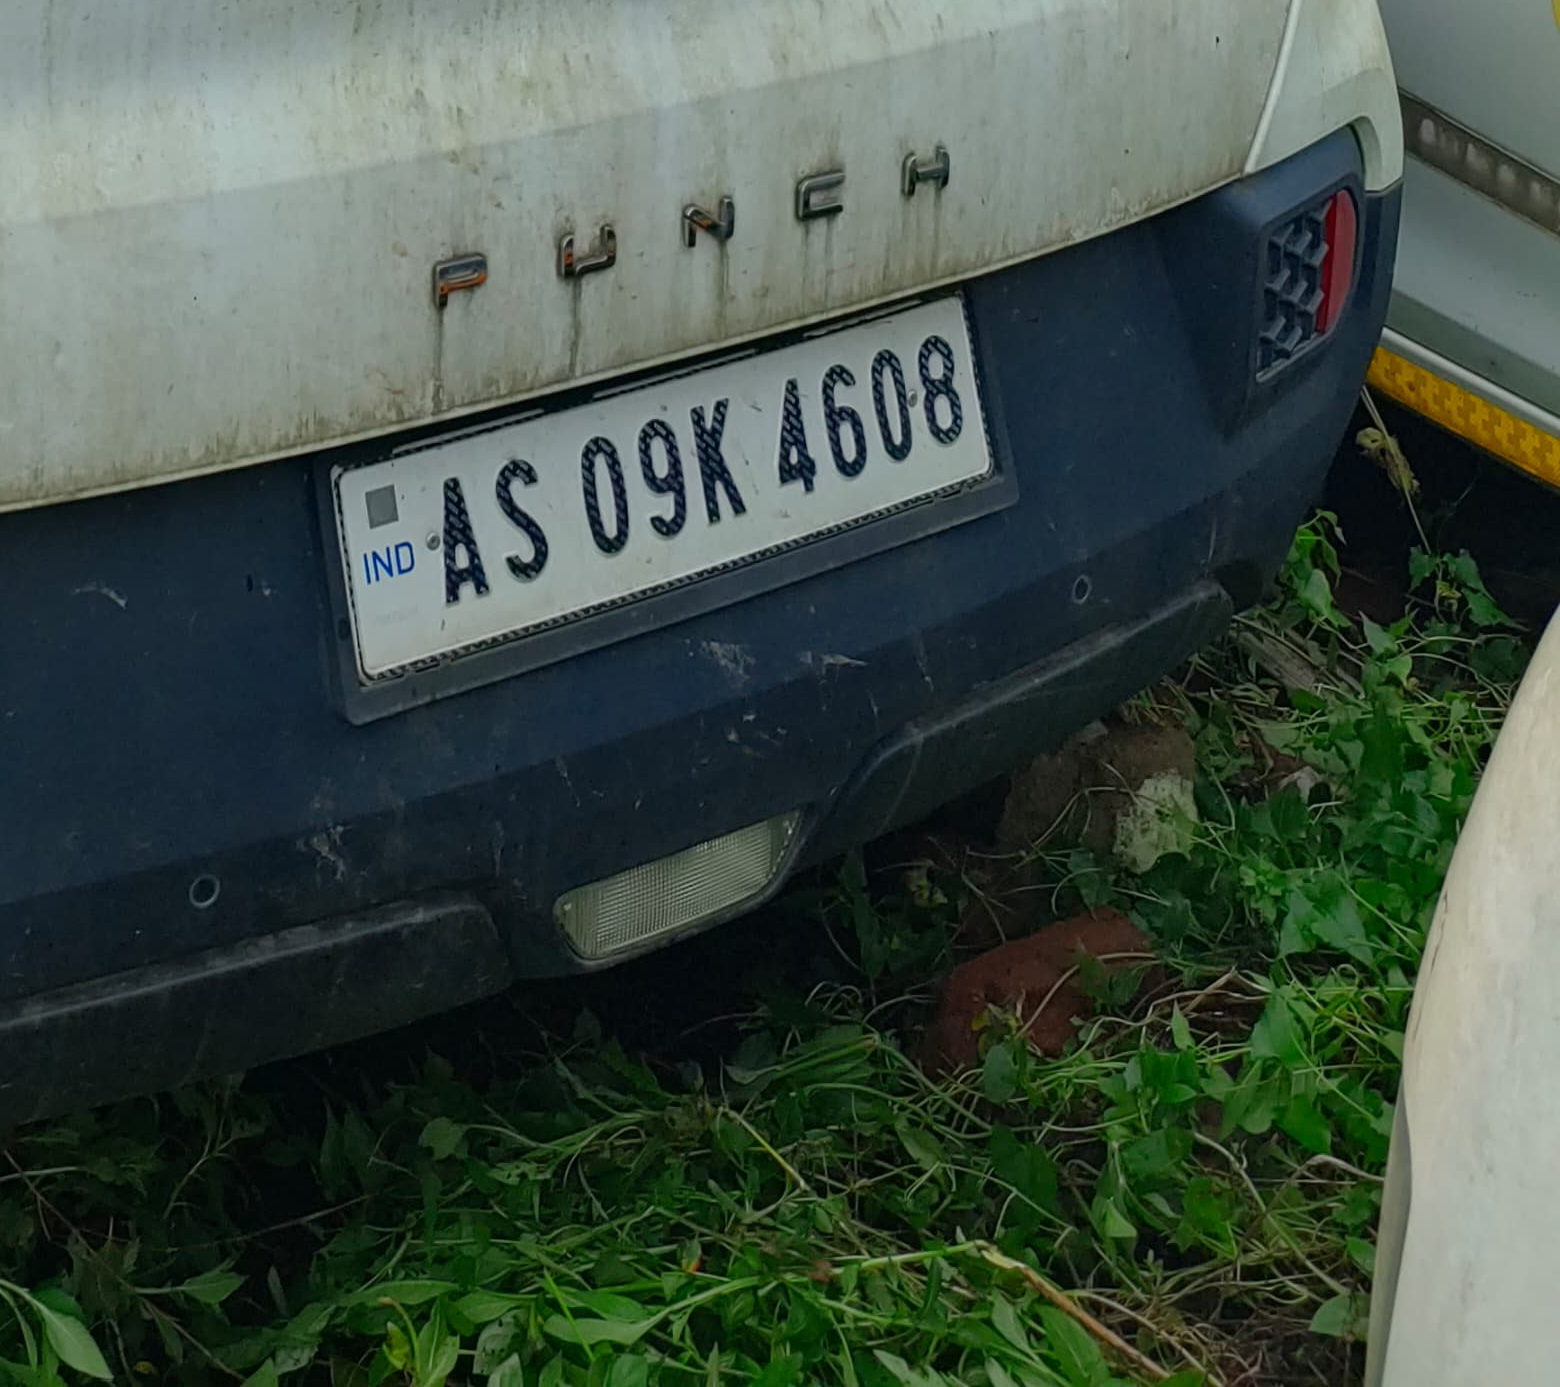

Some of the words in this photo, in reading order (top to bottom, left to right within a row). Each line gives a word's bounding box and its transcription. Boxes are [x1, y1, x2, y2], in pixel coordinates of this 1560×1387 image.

[432, 144, 950, 308] PUNCH
[443, 458, 549, 607] AS
[580, 397, 747, 555] 09K
[777, 334, 963, 494] 4608
[362, 540, 417, 586] IND
